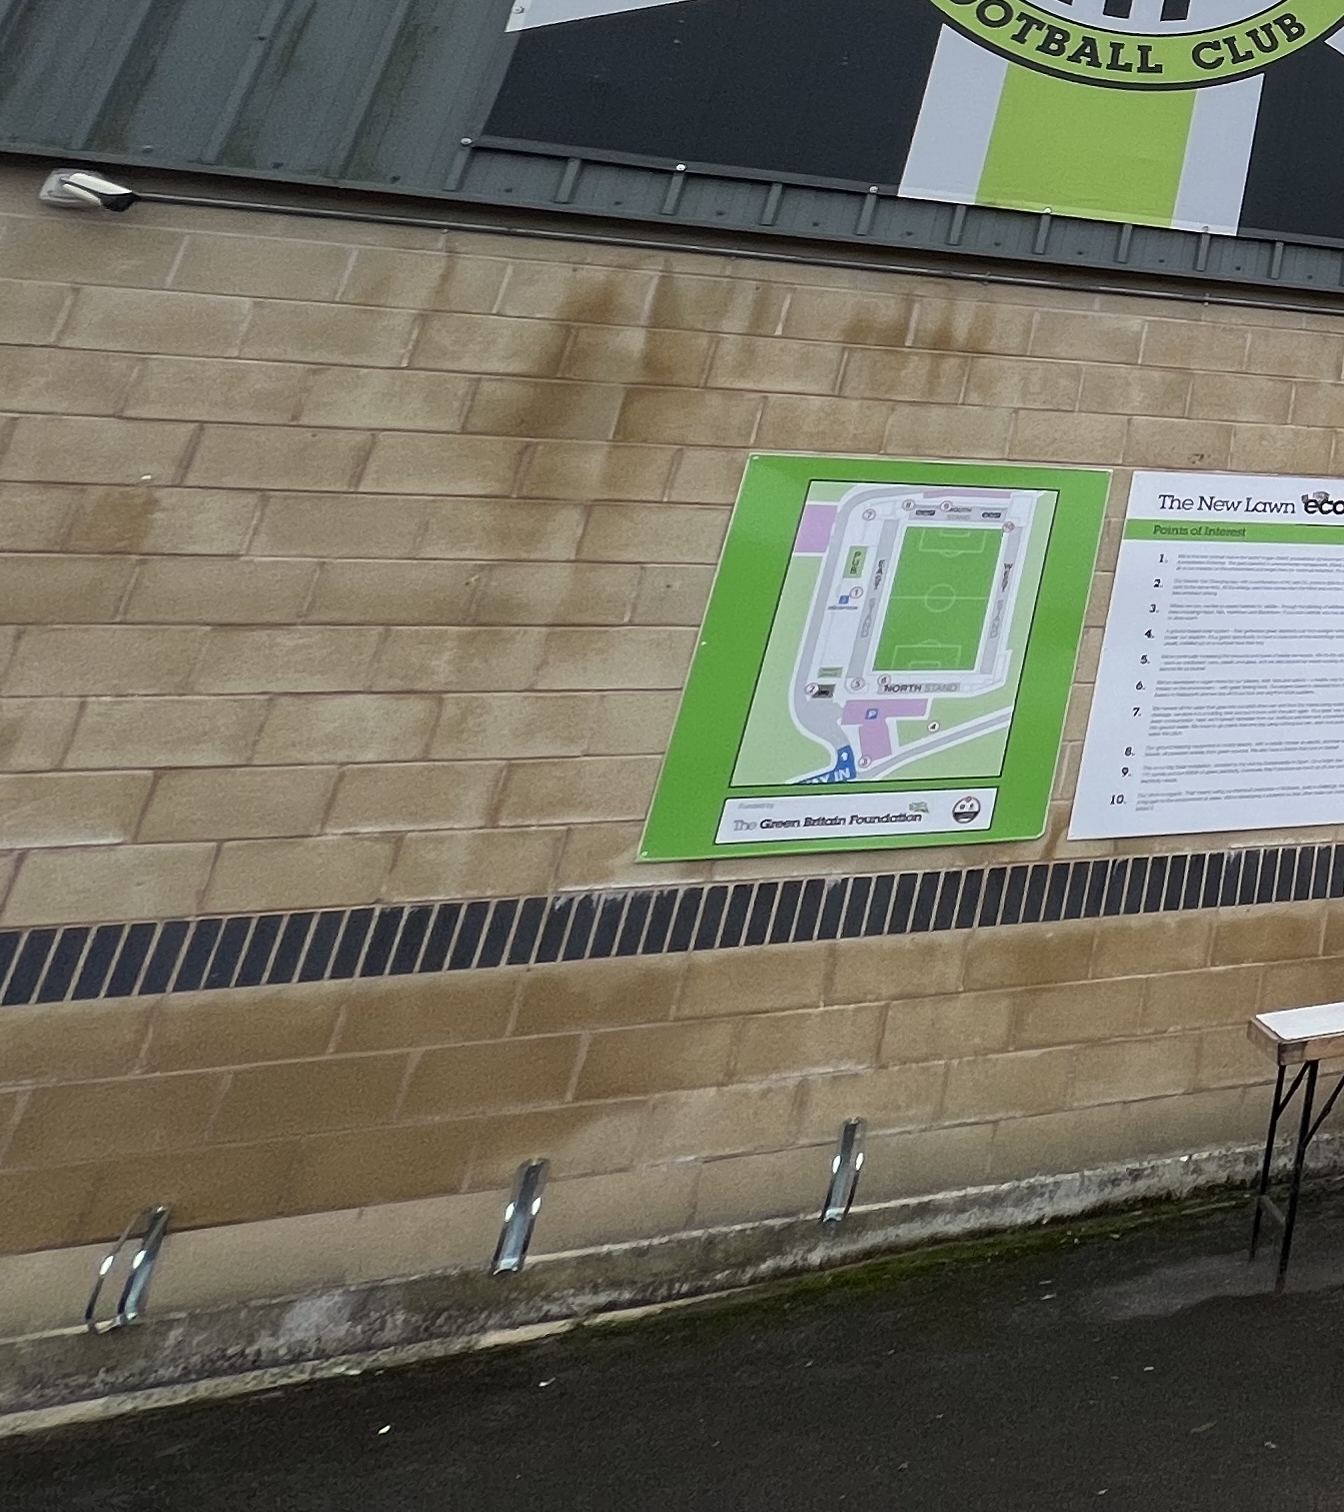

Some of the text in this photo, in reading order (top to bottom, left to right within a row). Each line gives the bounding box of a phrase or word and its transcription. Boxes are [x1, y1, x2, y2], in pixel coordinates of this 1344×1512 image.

[1190, 12, 1307, 71] CLUB
[1158, 494, 1194, 511] The
[1197, 496, 1242, 512] New
[1244, 497, 1296, 514] Lawn
[1153, 525, 1246, 538] Points of Interest
[884, 684, 922, 692] NORTH
[760, 818, 800, 830] Green
[802, 816, 846, 828] Britain
[848, 812, 922, 826] Foundation
